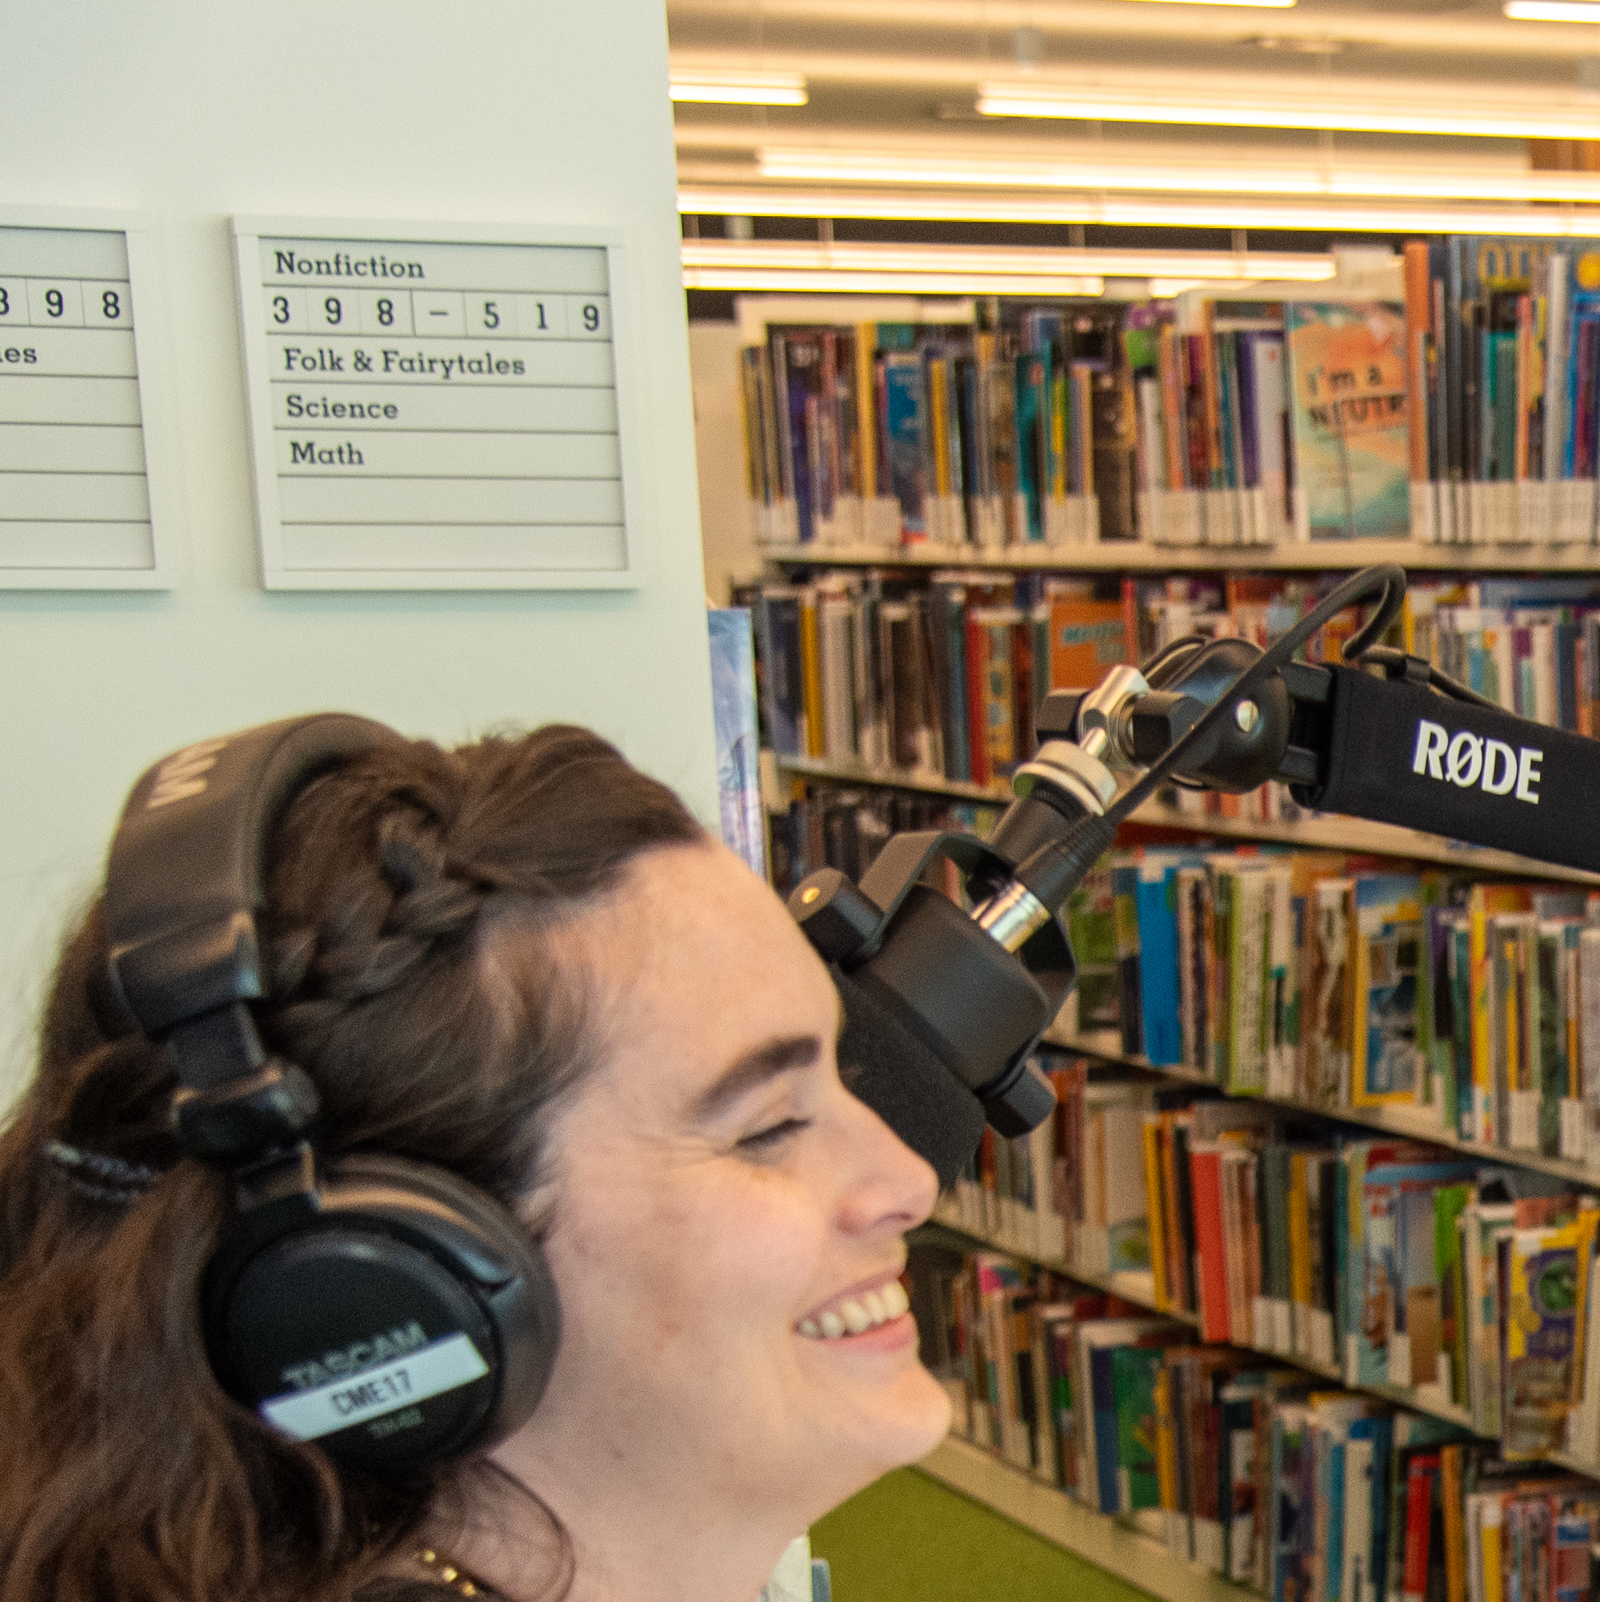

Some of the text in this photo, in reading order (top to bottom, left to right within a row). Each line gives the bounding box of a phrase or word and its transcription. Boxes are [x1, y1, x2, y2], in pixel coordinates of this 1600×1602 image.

[274, 250, 425, 280] Nonfiction
[284, 347, 526, 380] Folk & Fairytales
[286, 394, 399, 420] Science
[289, 440, 365, 467] Math
[1412, 718, 1544, 805] RØDE
[330, 1368, 413, 1417] CME17
